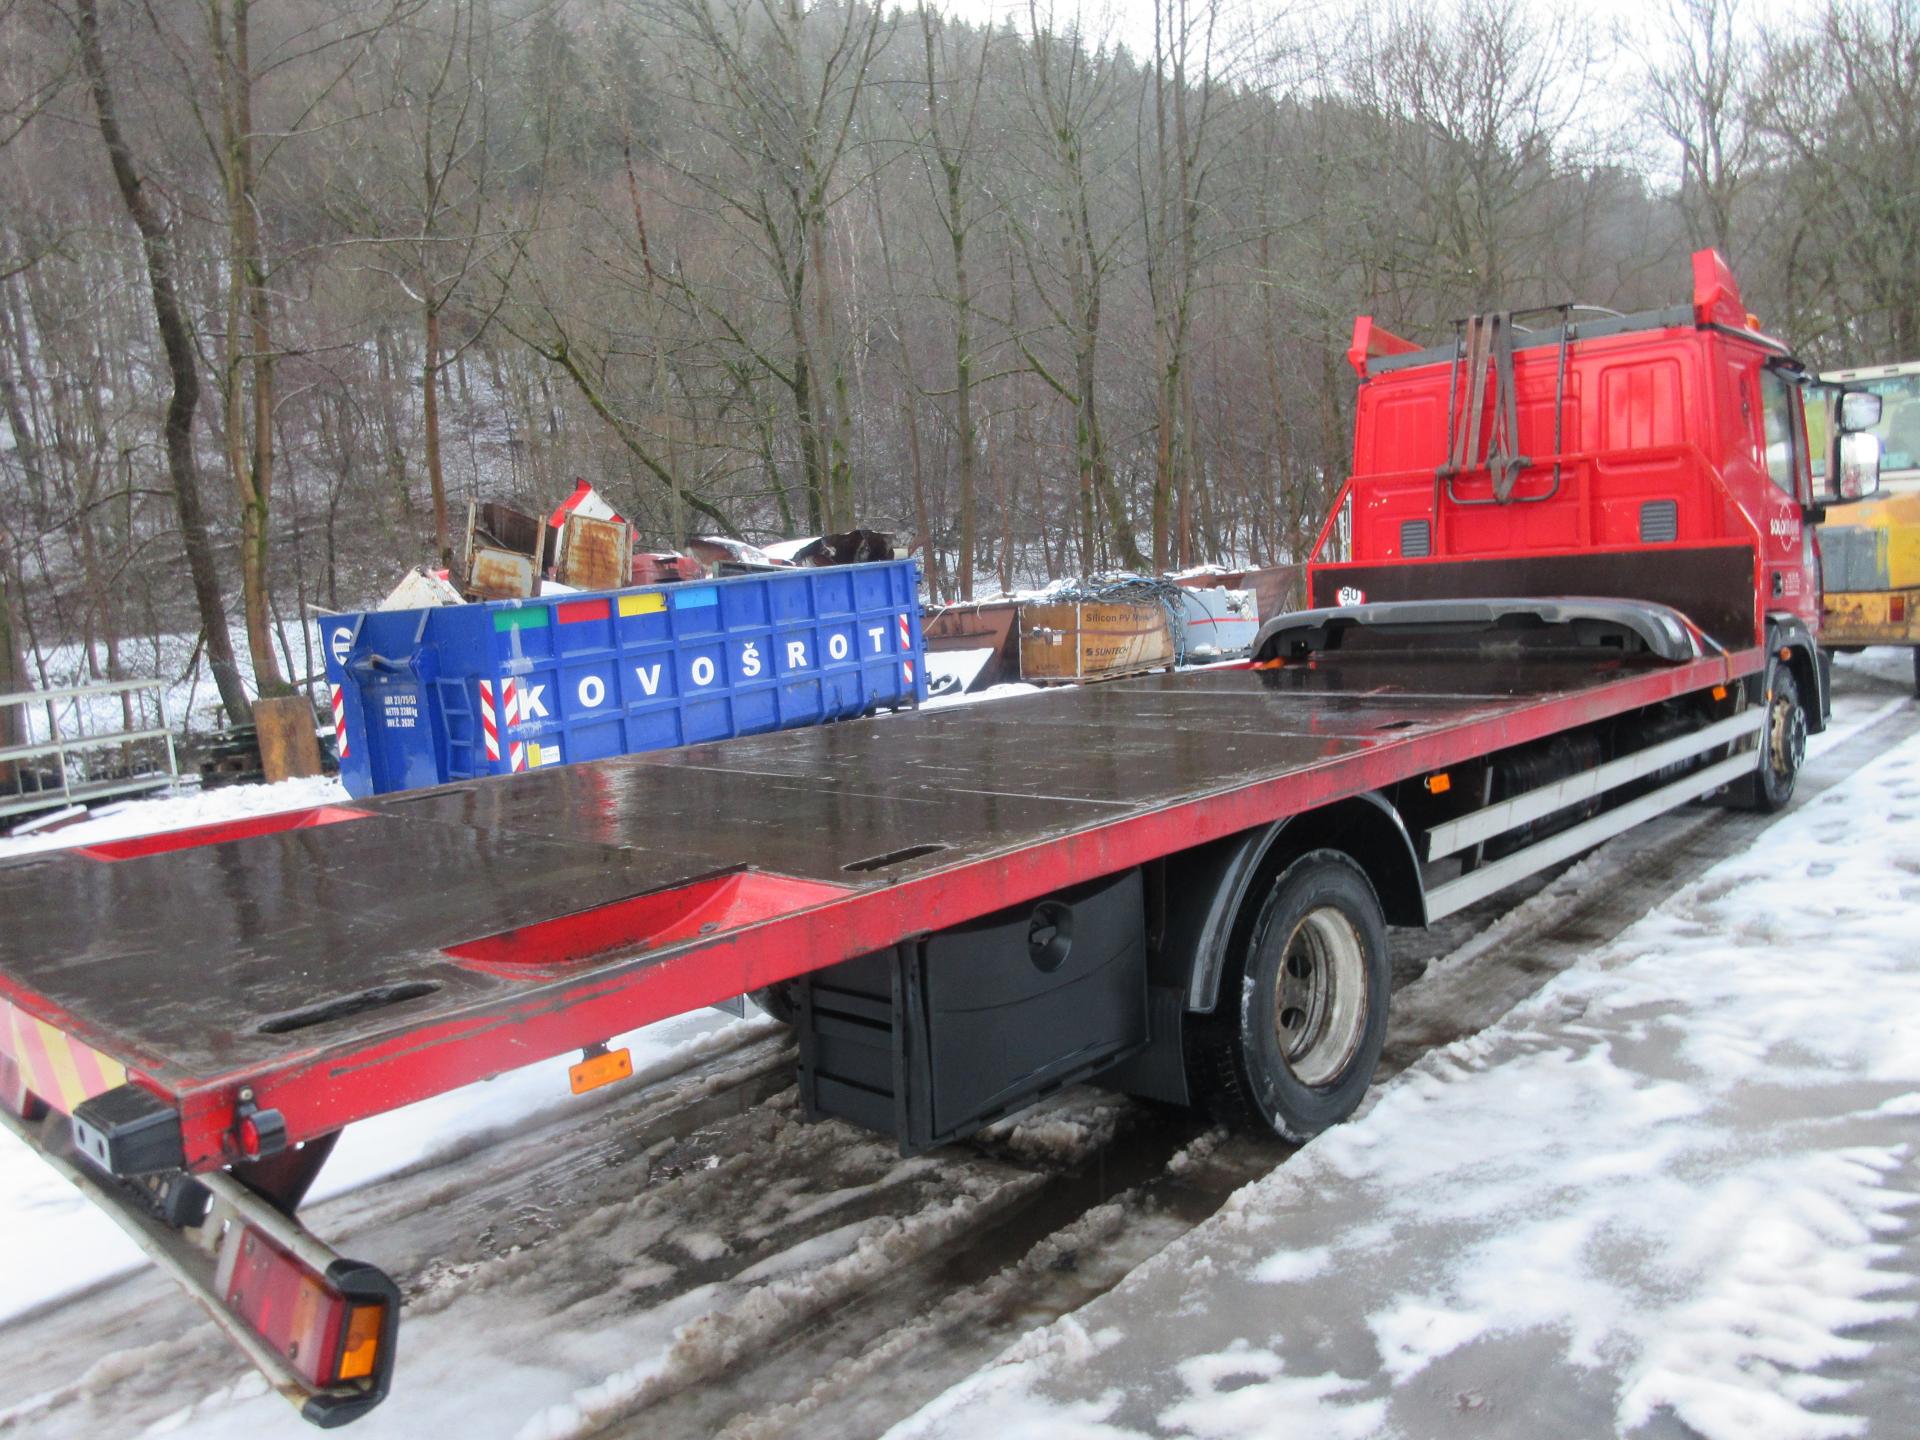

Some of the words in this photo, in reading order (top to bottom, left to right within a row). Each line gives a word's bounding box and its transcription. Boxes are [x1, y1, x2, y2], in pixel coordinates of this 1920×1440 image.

[1342, 588, 1358, 601] 90
[1086, 613, 1117, 622] Silicon
[1119, 614, 1131, 622] PV
[1095, 646, 1129, 656] SUNTECH
[519, 627, 885, 721] KOVOŠROT
